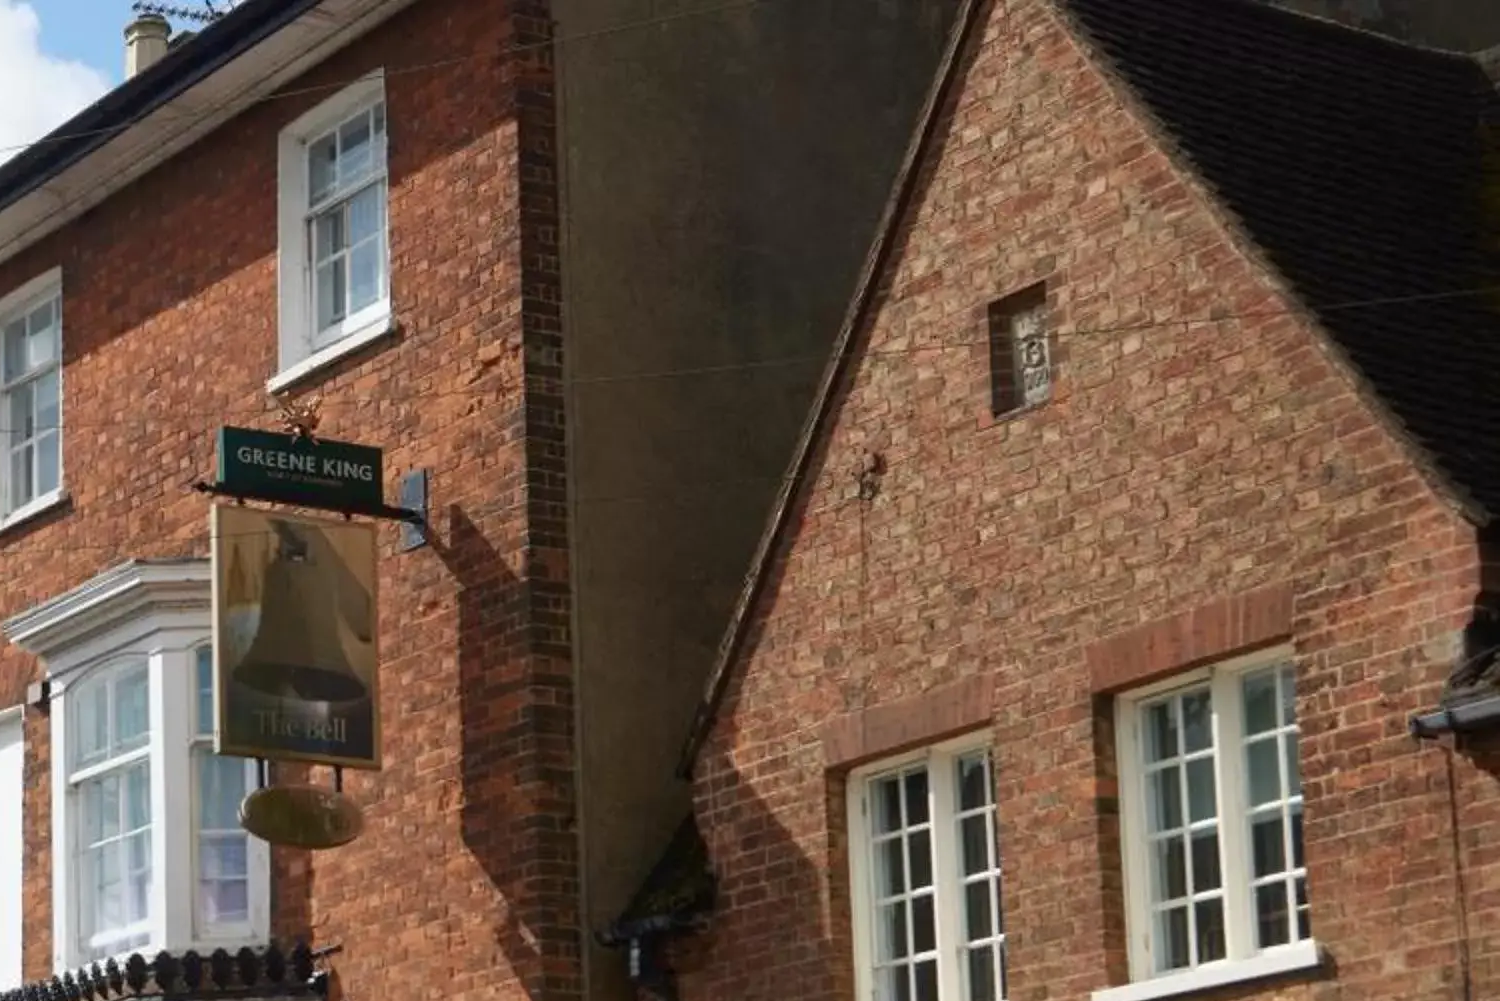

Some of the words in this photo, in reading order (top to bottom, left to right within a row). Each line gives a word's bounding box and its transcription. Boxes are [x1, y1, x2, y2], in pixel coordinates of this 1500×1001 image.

[237, 446, 316, 474] GREENE
[323, 457, 373, 481] KING
[251, 709, 300, 738] The
[304, 717, 347, 743] Bell
